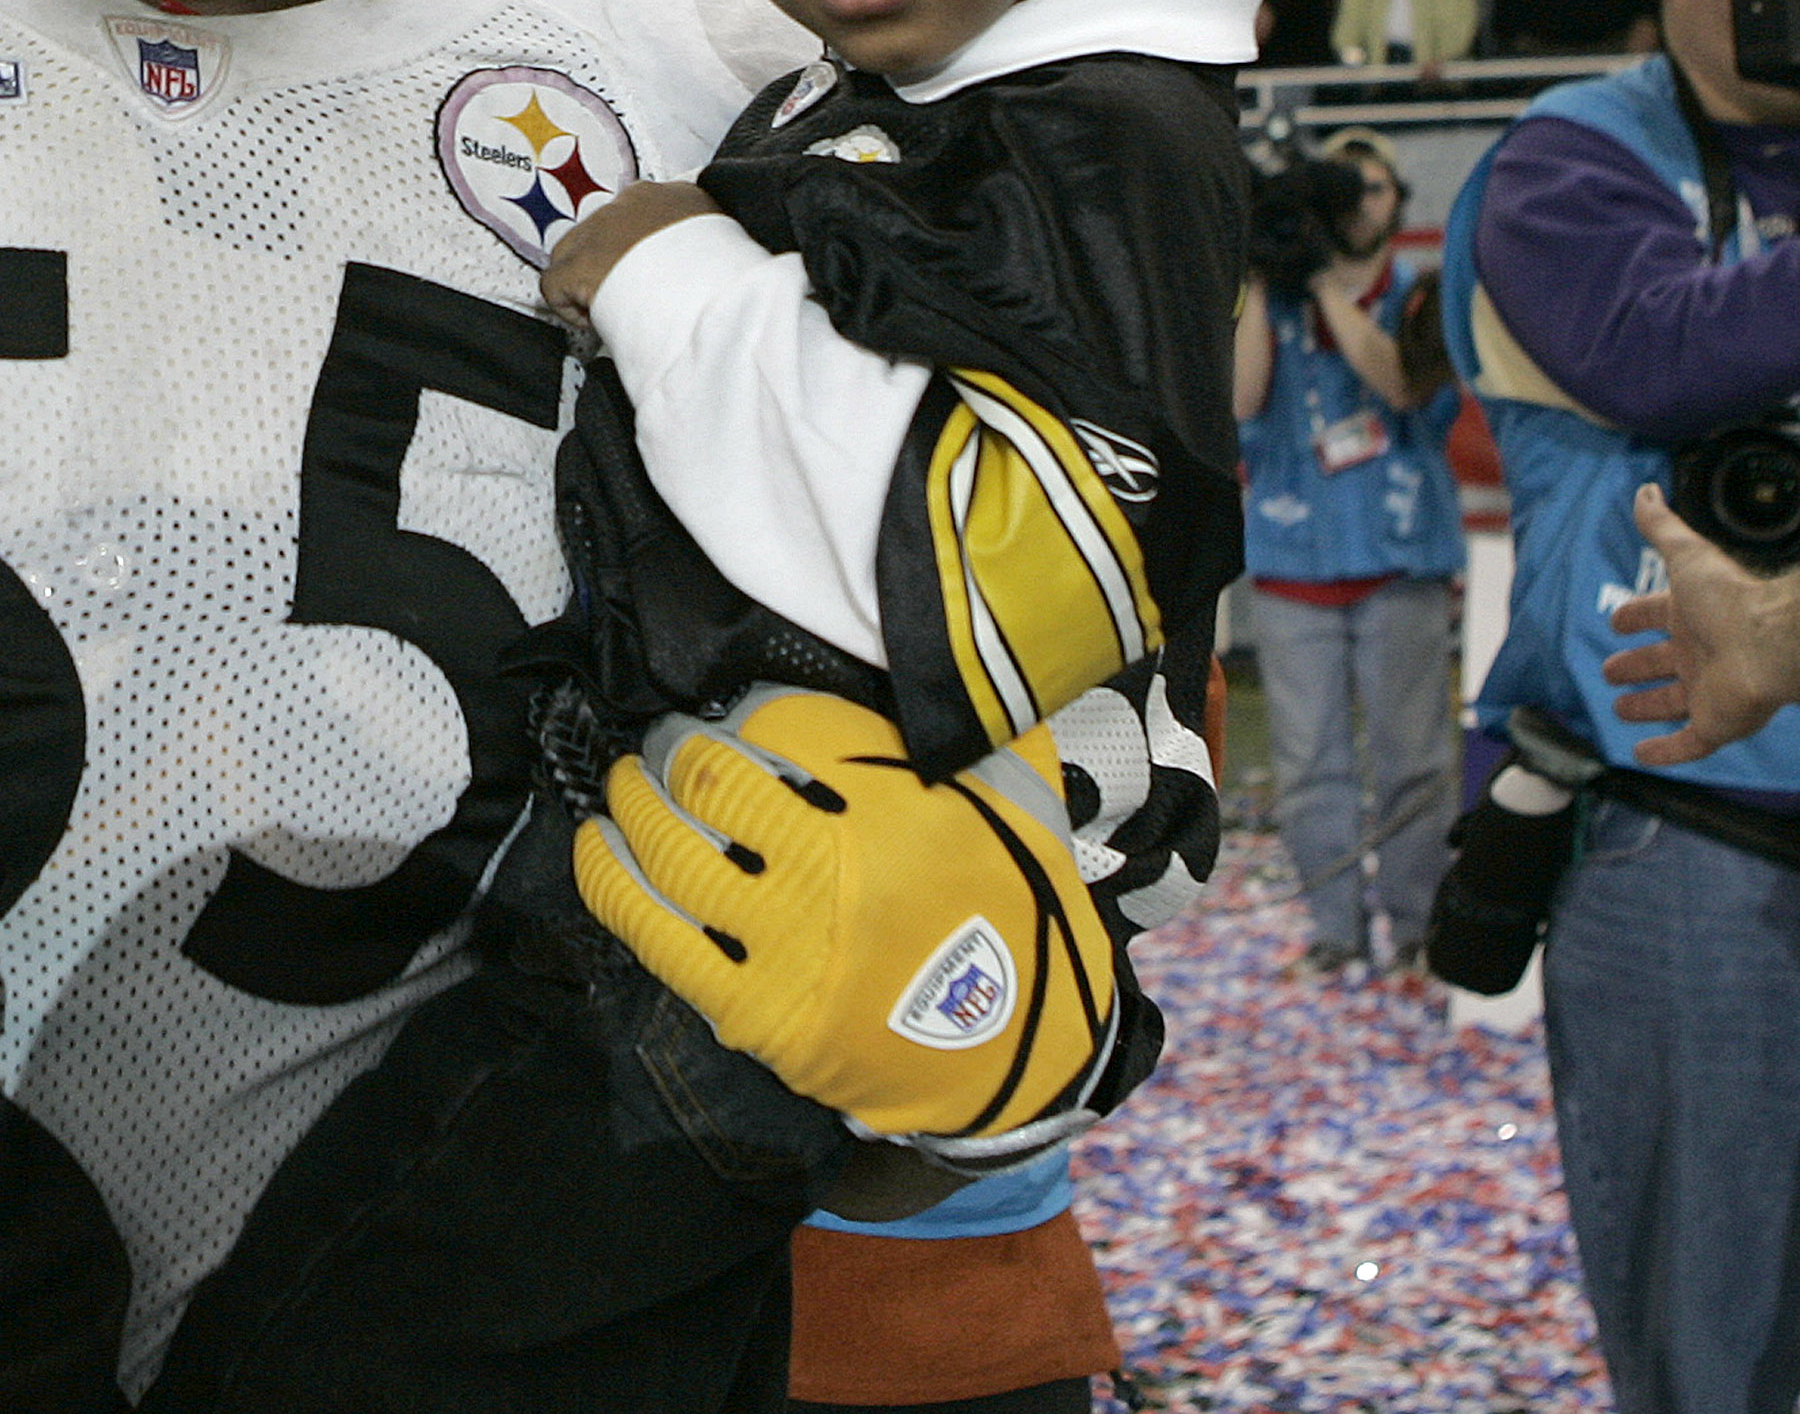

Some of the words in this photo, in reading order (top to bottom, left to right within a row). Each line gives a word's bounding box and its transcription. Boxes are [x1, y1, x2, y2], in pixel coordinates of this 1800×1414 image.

[146, 62, 196, 98] NFL
[460, 135, 533, 173] Steelers
[908, 932, 984, 1023] EQUIPMENT
[952, 983, 998, 1028] NFL
